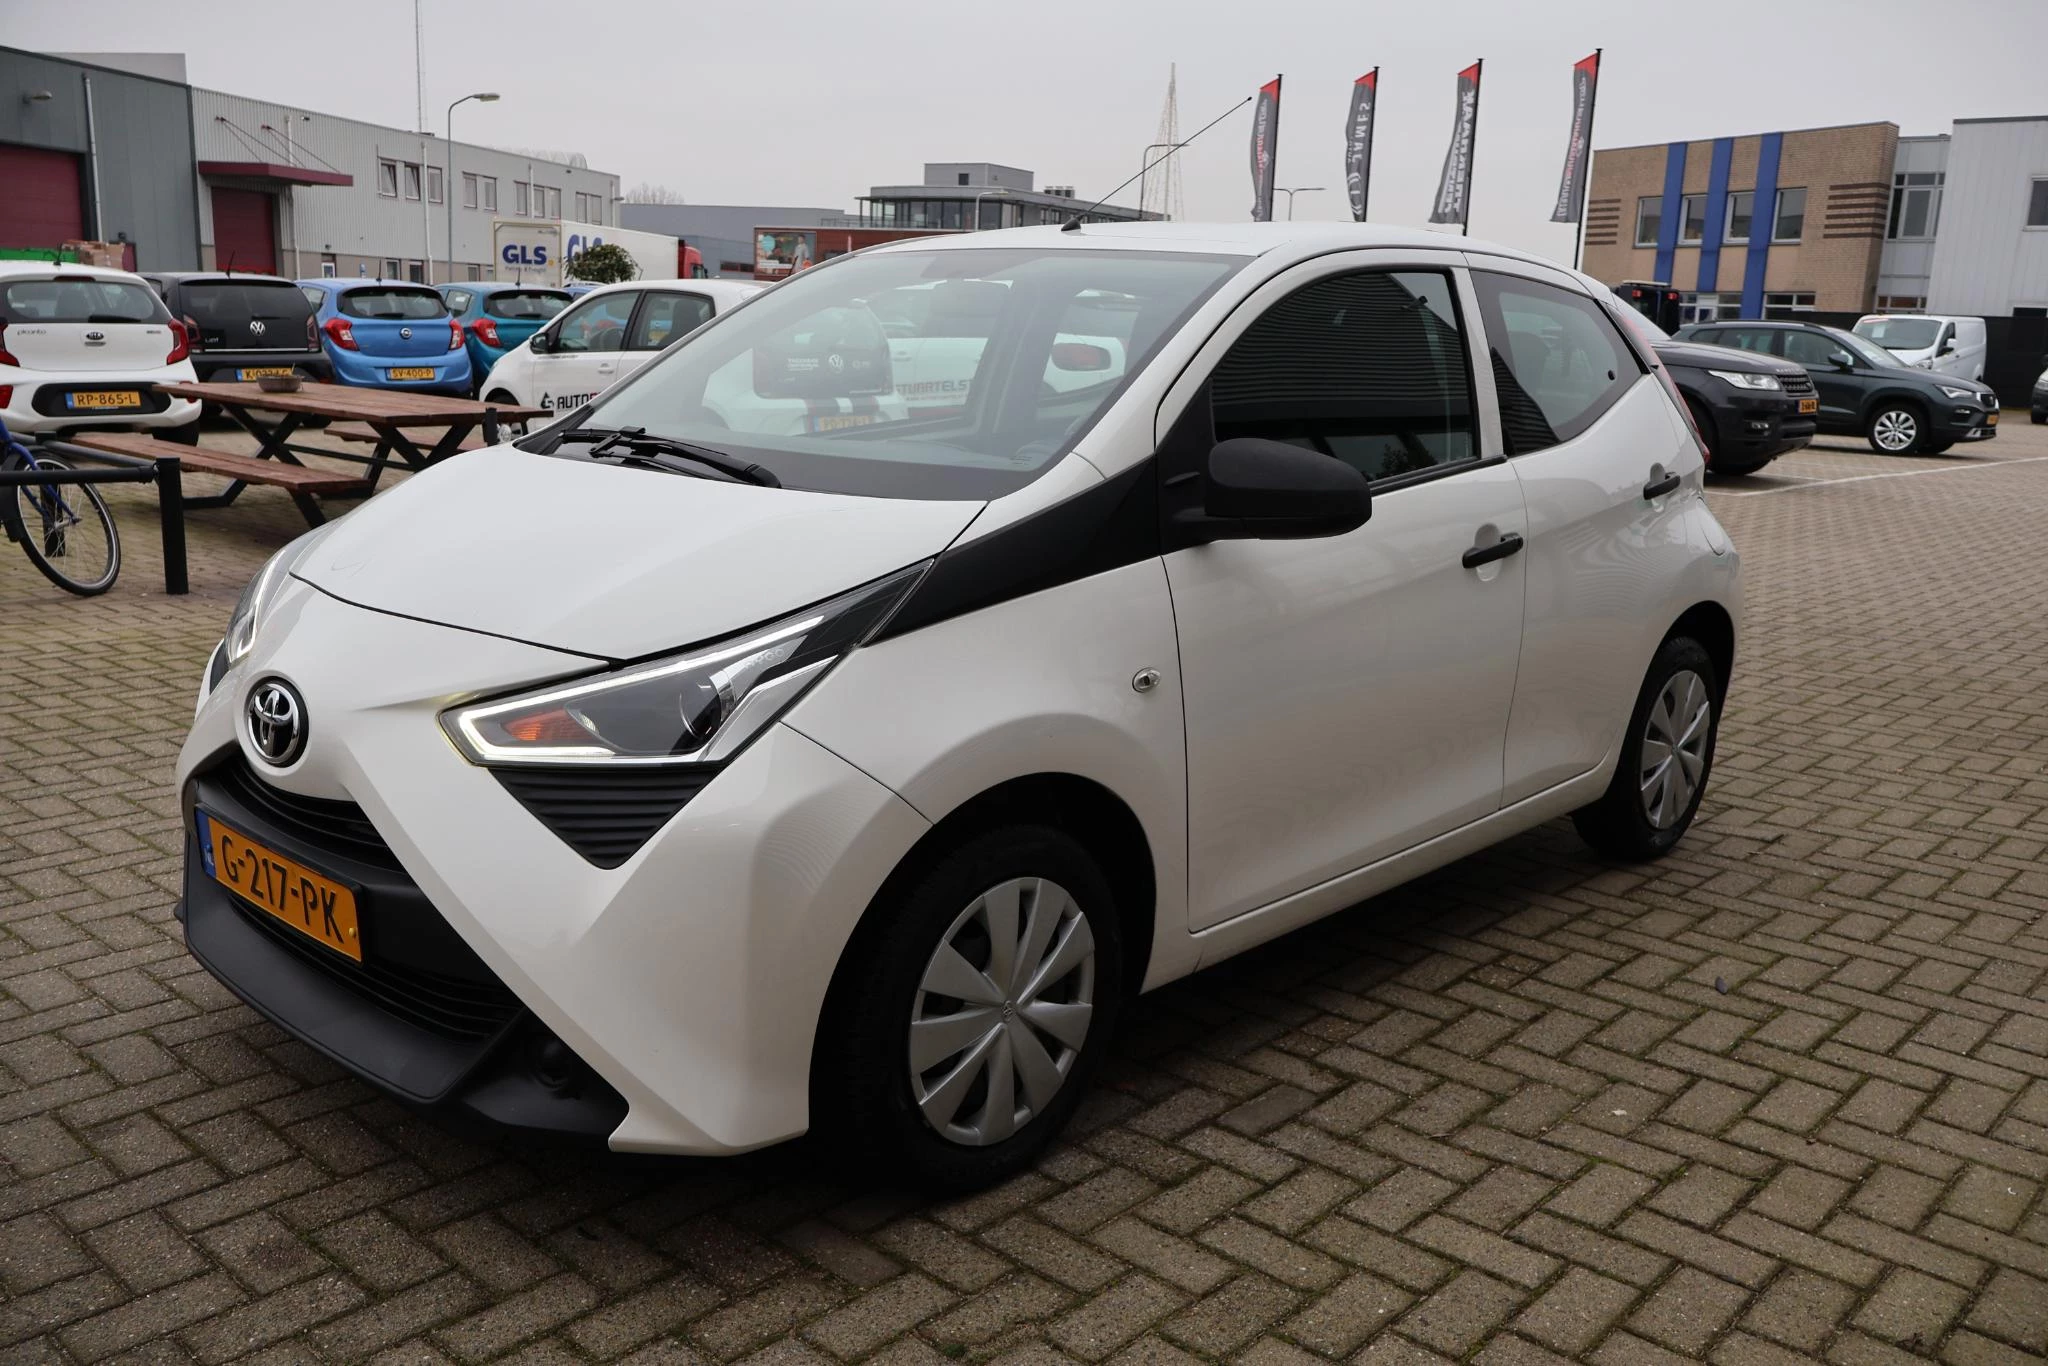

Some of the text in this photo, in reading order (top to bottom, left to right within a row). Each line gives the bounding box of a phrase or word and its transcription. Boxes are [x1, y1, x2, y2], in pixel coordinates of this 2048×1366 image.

[502, 244, 547, 265] GLS
[392, 368, 431, 377] SV-400-P
[77, 394, 136, 405] RP-865-L
[221, 834, 345, 945] G-217-PK
